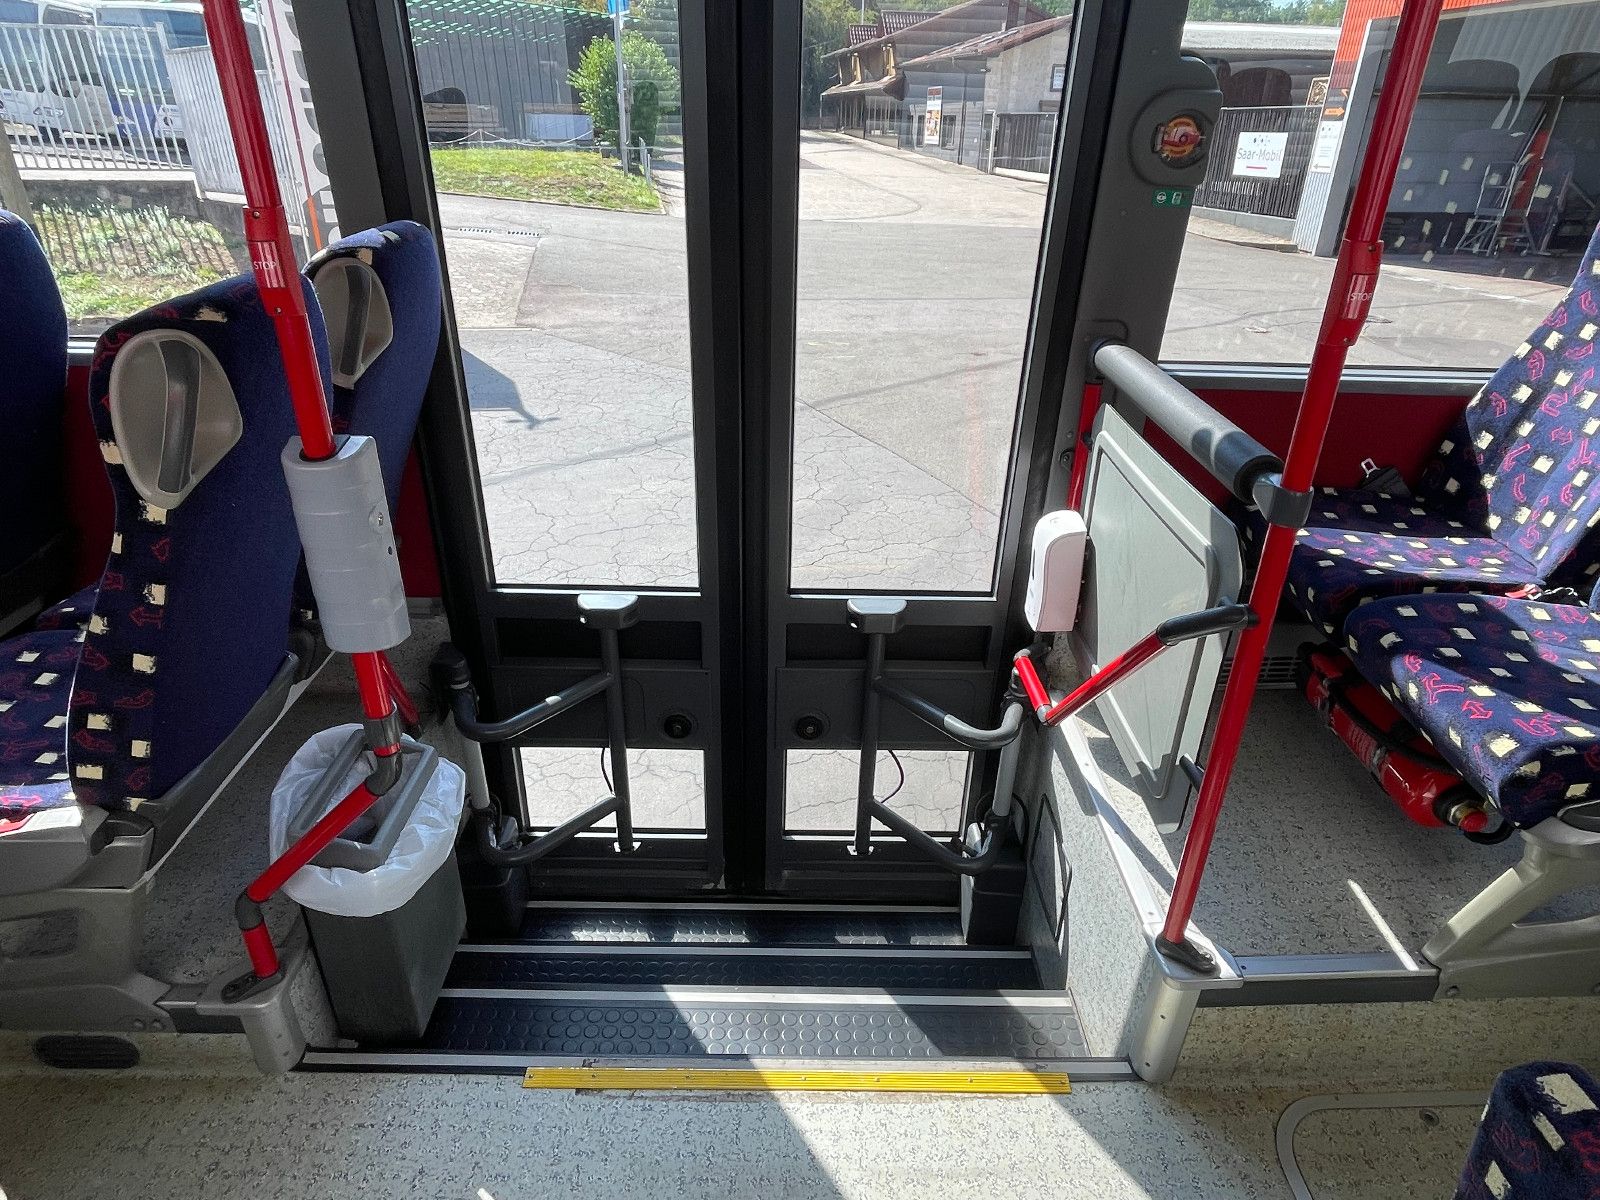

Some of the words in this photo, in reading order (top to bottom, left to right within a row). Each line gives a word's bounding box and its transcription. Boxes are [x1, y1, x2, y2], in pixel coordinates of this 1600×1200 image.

[1237, 148, 1282, 161] Saar-Mobil
[253, 261, 277, 270] STOP
[1350, 292, 1373, 301] STOP
